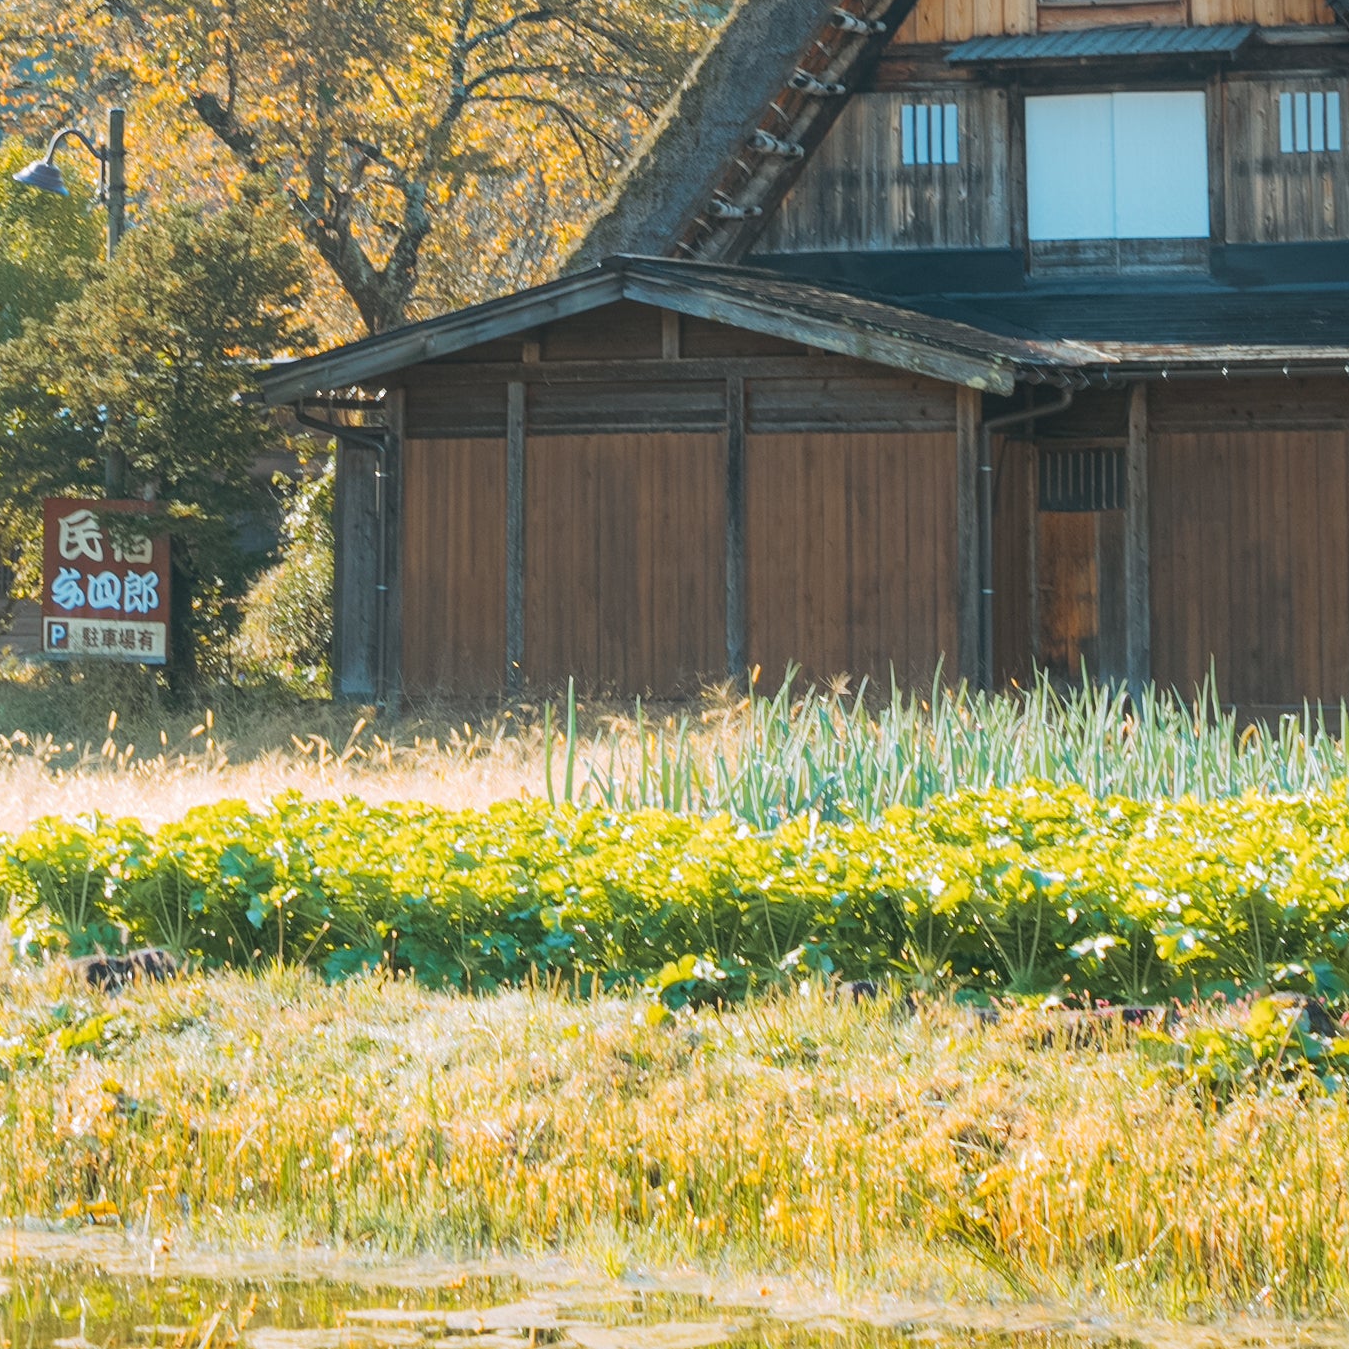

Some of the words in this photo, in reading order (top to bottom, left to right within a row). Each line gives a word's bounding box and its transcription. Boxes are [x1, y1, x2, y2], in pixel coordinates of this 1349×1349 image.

[51, 624, 66, 646] P
[82, 627, 154, 651] 駐車場有
